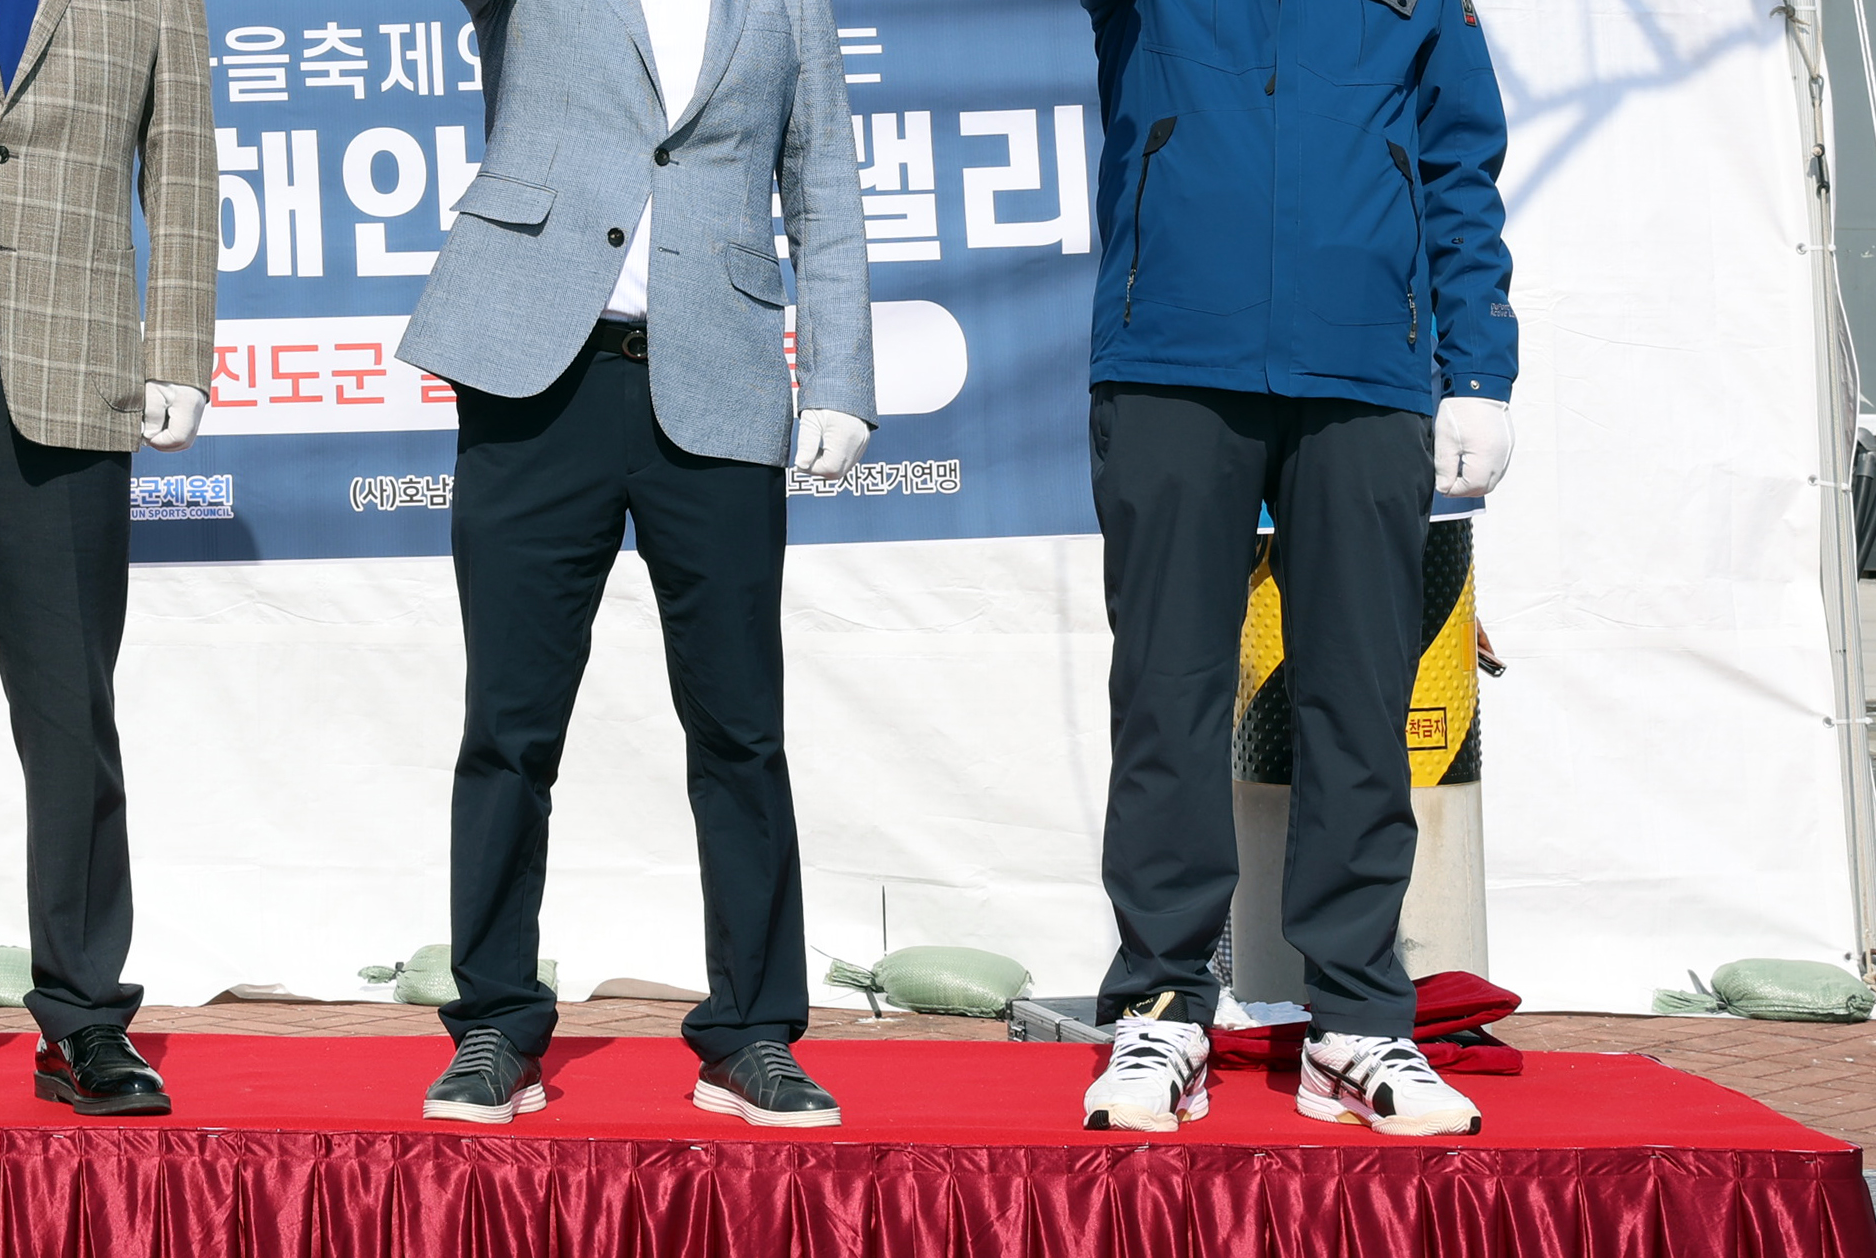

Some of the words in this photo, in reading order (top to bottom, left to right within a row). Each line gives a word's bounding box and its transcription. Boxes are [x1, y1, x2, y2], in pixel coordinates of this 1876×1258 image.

[209, 21, 483, 102] 을축제
[210, 342, 387, 408] 진도군
[352, 476, 454, 509] (사)호남
[148, 508, 187, 519] SPORTS
[189, 507, 233, 518] COUNCIL
[1405, 716, 1444, 739] 착금지
